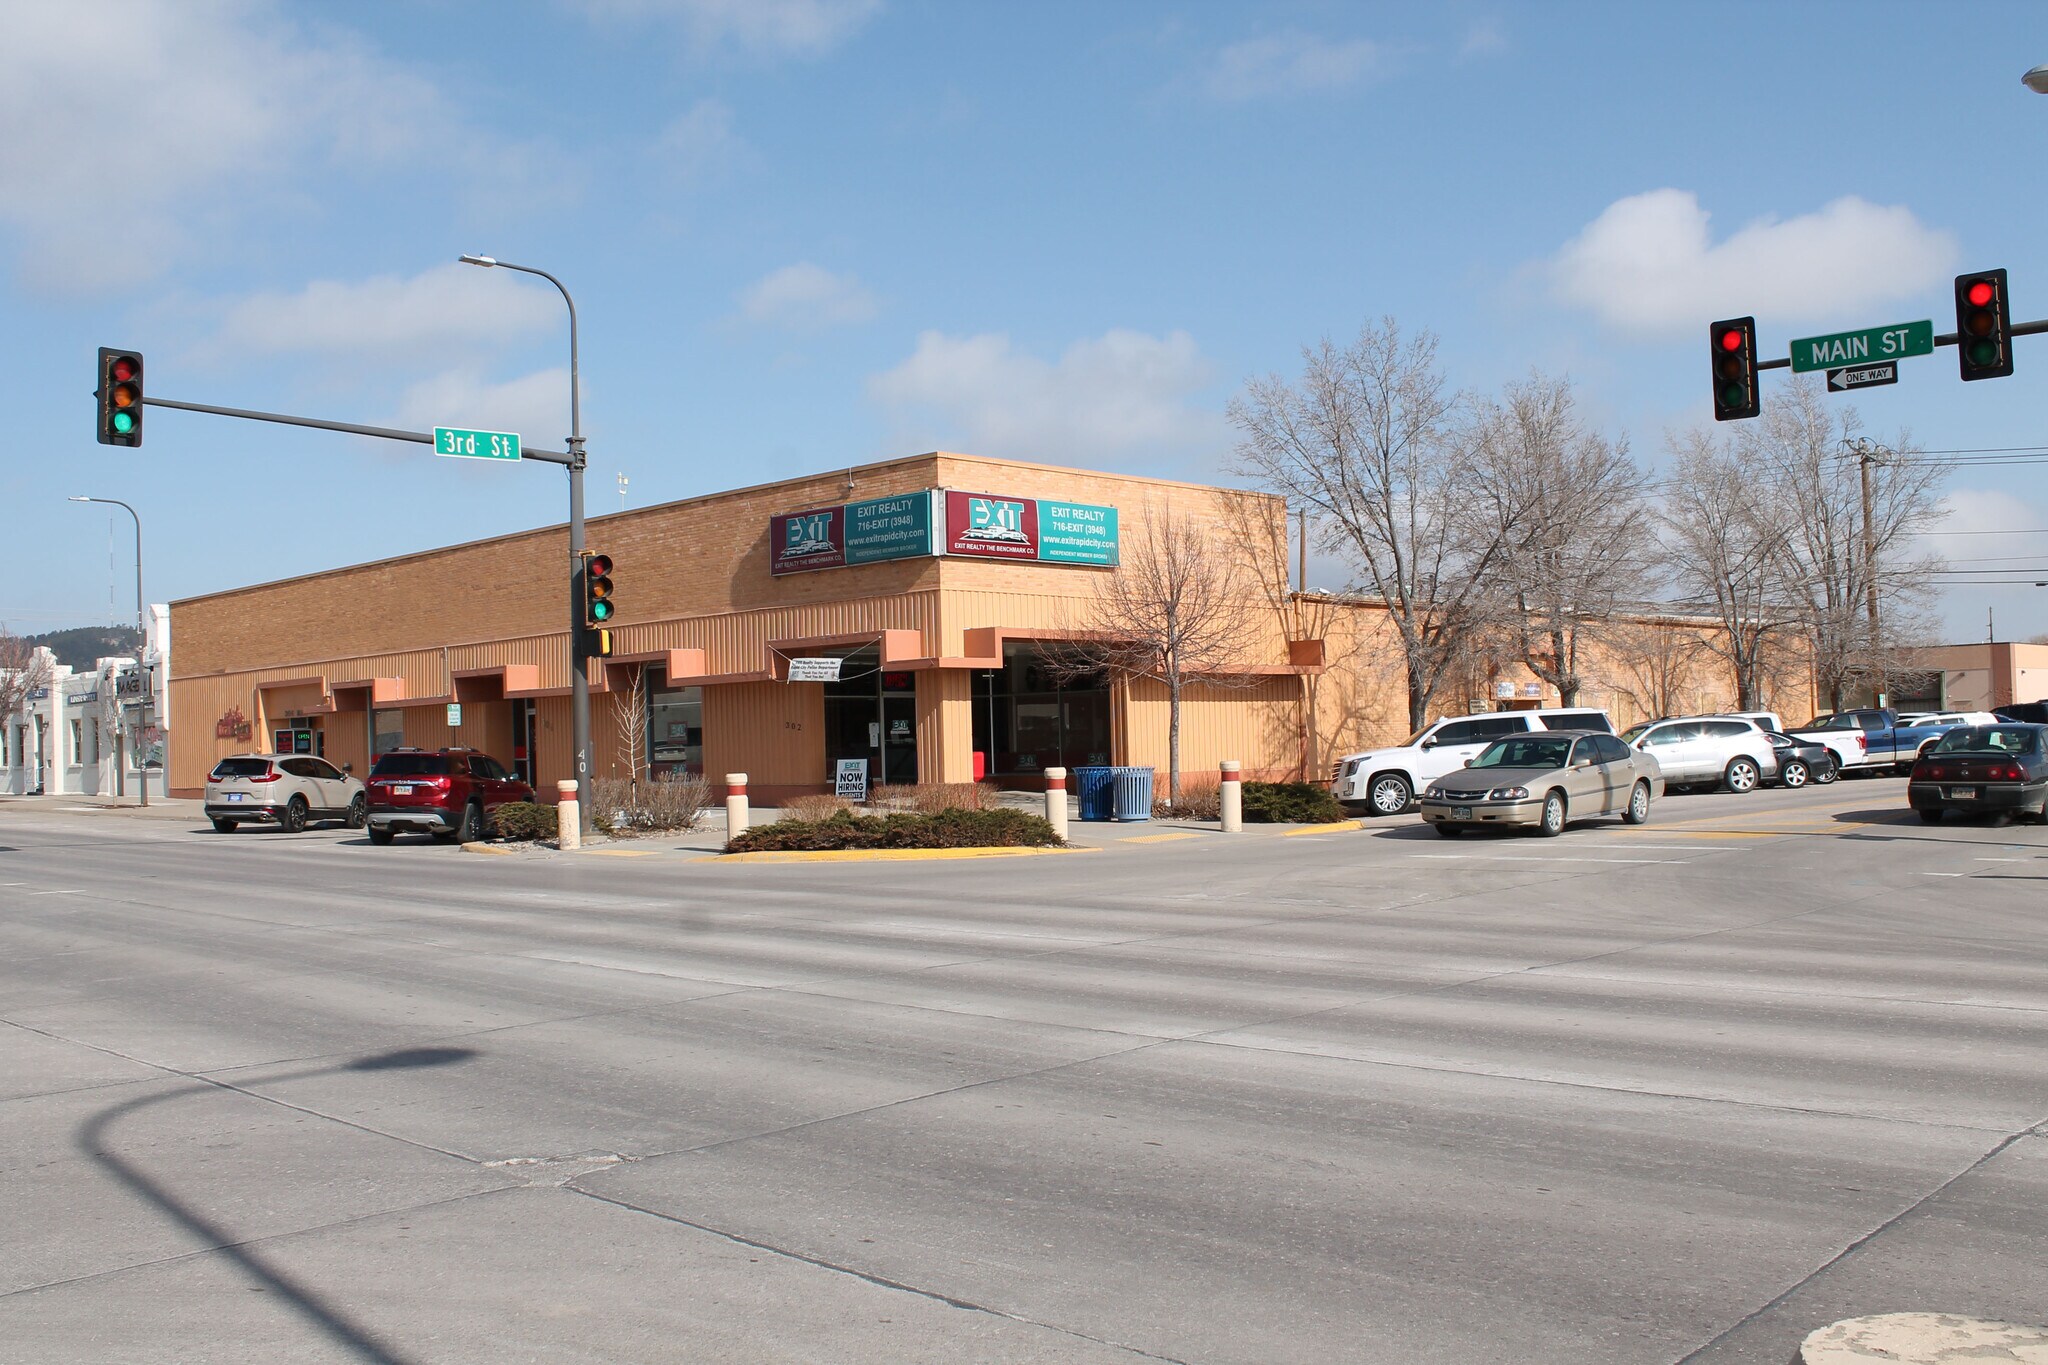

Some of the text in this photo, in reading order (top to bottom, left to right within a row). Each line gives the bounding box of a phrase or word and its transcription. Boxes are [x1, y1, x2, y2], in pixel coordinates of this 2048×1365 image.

[1812, 329, 1909, 365] MAIN ST
[1846, 368, 1889, 383] ONE WAY
[445, 431, 510, 457] 3rd St
[857, 499, 912, 518] EXIT REALTY
[1051, 507, 1105, 522] EXIT REALTY
[857, 515, 914, 532] 716-EXIT (3948)
[1053, 522, 1106, 537] 716-EXIT (3948)
[848, 529, 925, 546] www.exitrapidcity.com
[1043, 536, 1116, 549] www.exitrapidcity.com
[966, 543, 985, 551] REALTY
[996, 545, 1027, 554] BENCHMARK
[785, 721, 802, 731] 302
[578, 749, 587, 773] 40
[845, 761, 861, 769] EXIT
[840, 772, 863, 783] NOW
[838, 782, 864, 791] HIRING
